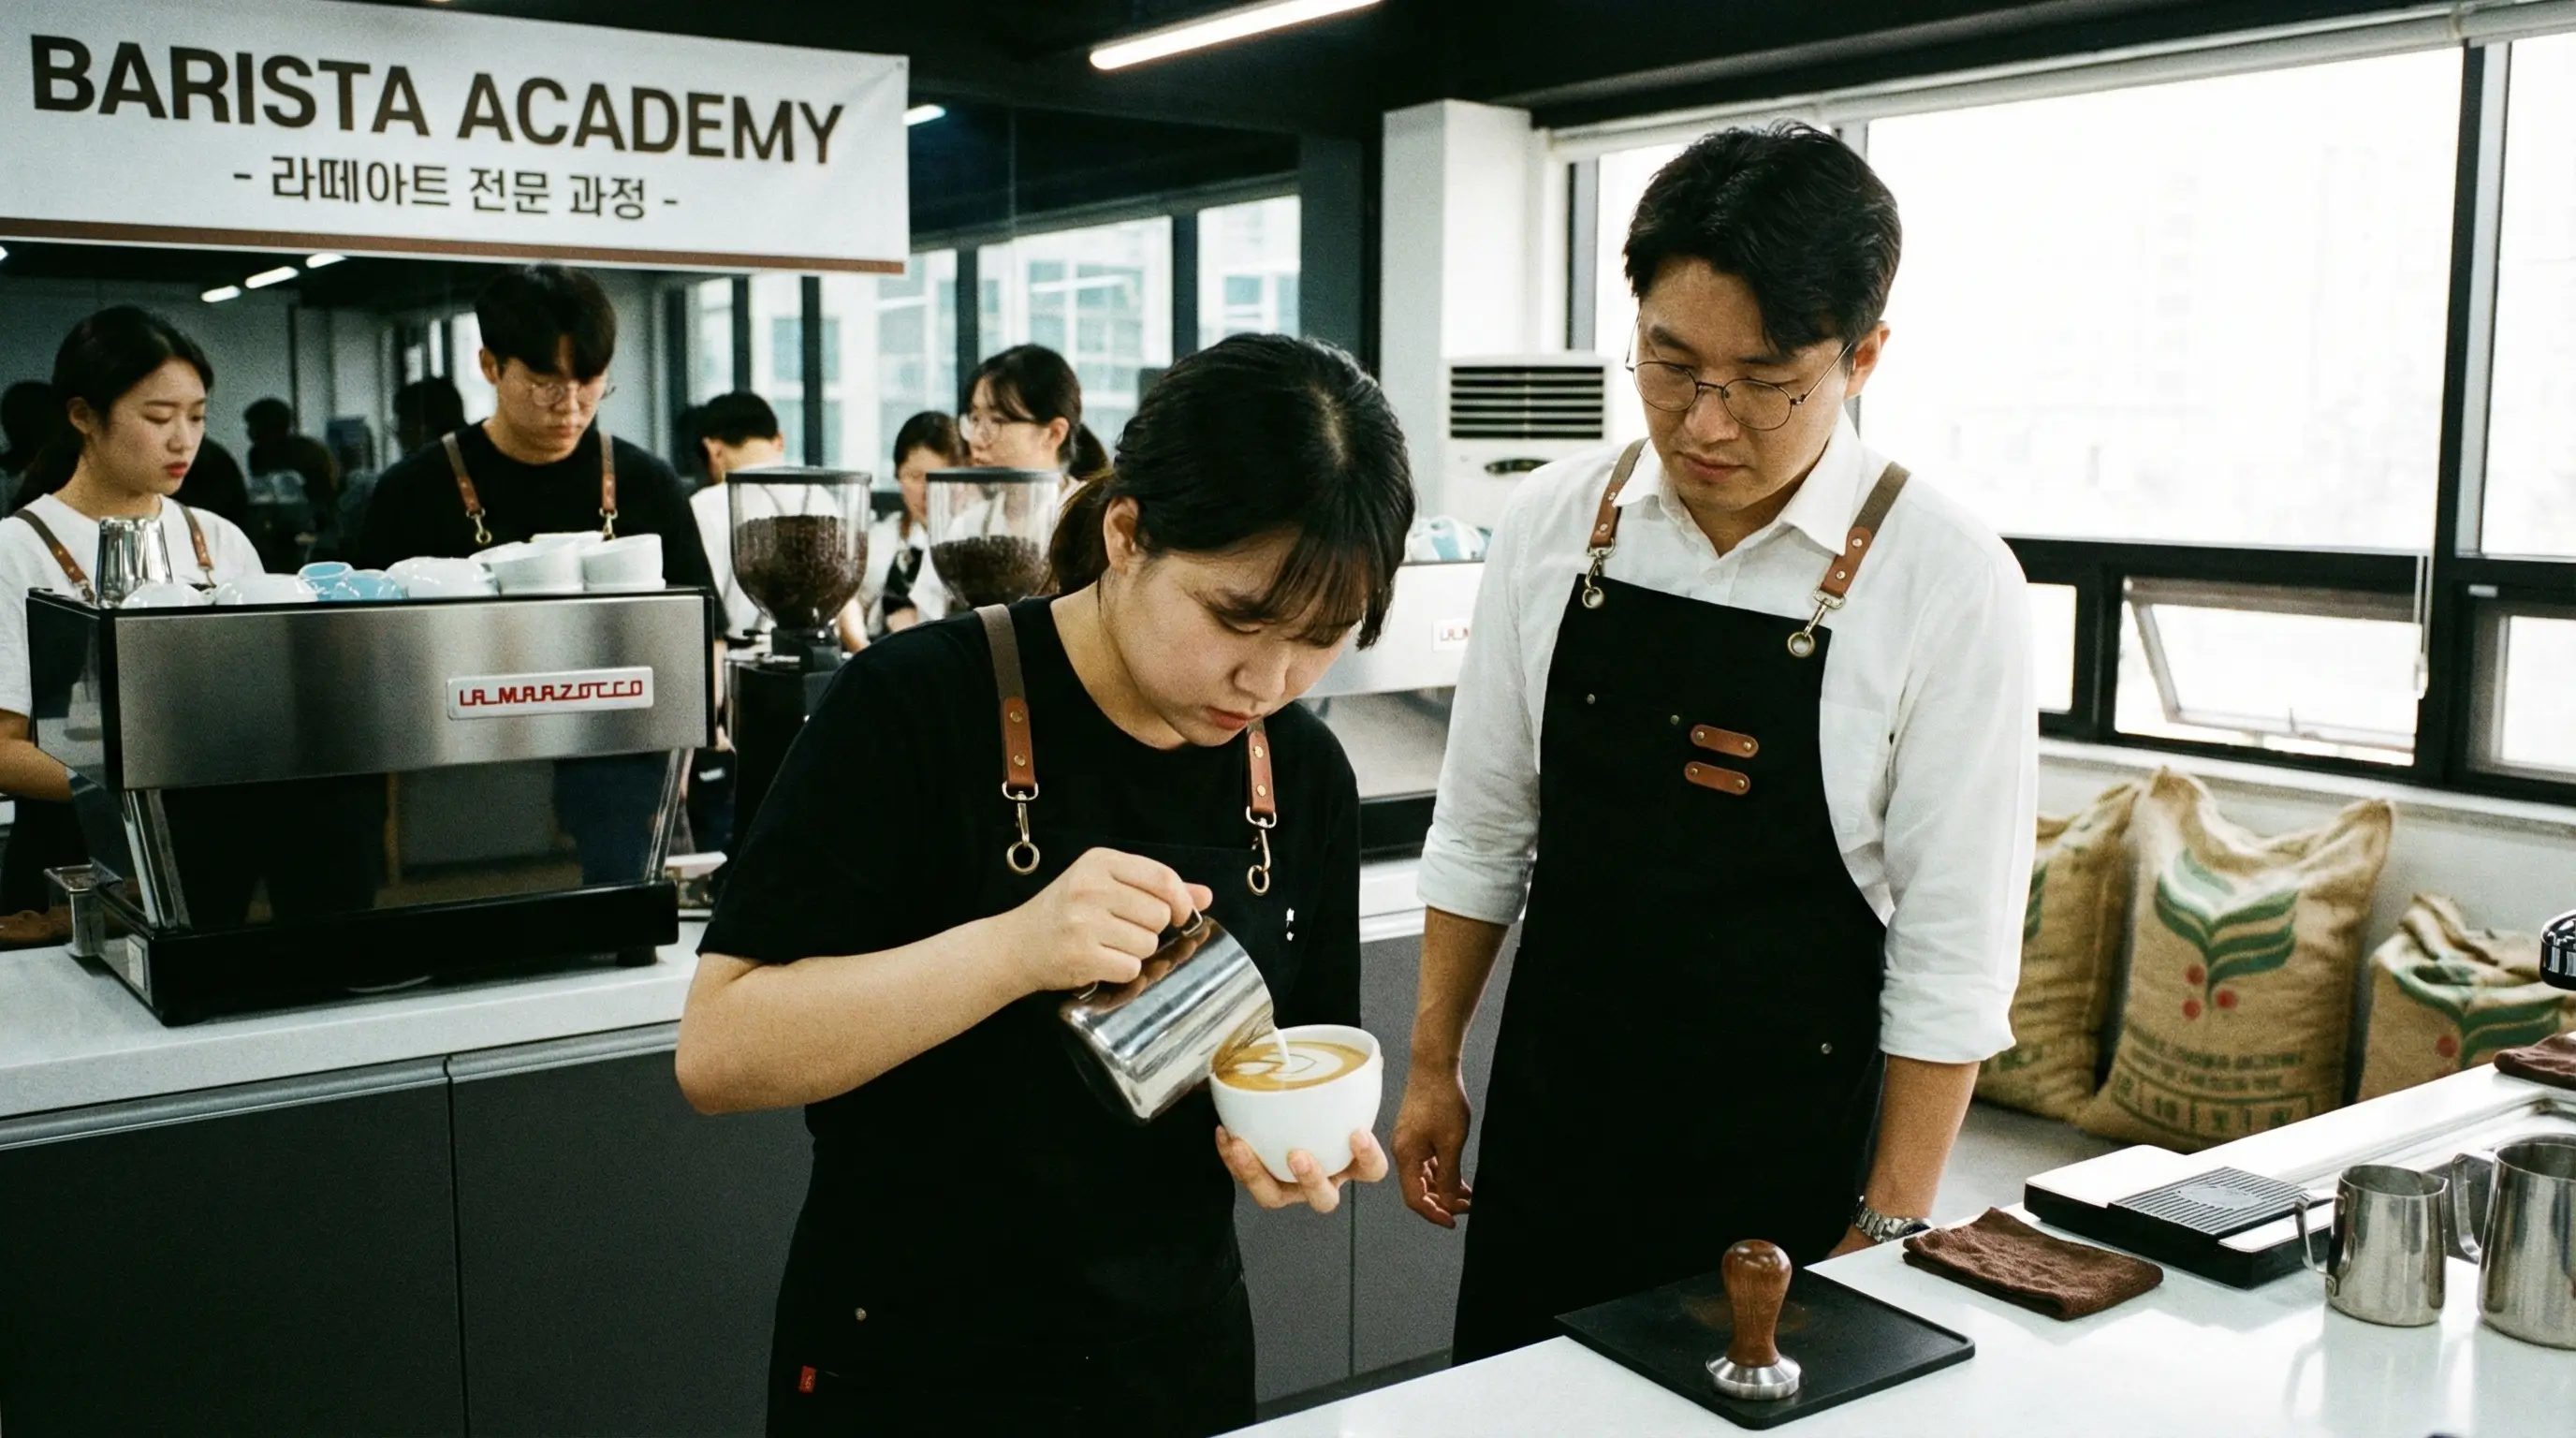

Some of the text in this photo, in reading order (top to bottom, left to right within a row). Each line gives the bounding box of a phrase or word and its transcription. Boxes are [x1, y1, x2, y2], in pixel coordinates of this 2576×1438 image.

[30, 34, 844, 165] BARISTA ACADEMY
[271, 155, 450, 206] 라떼아트
[470, 168, 549, 214] 전문
[569, 175, 645, 221] 과정
